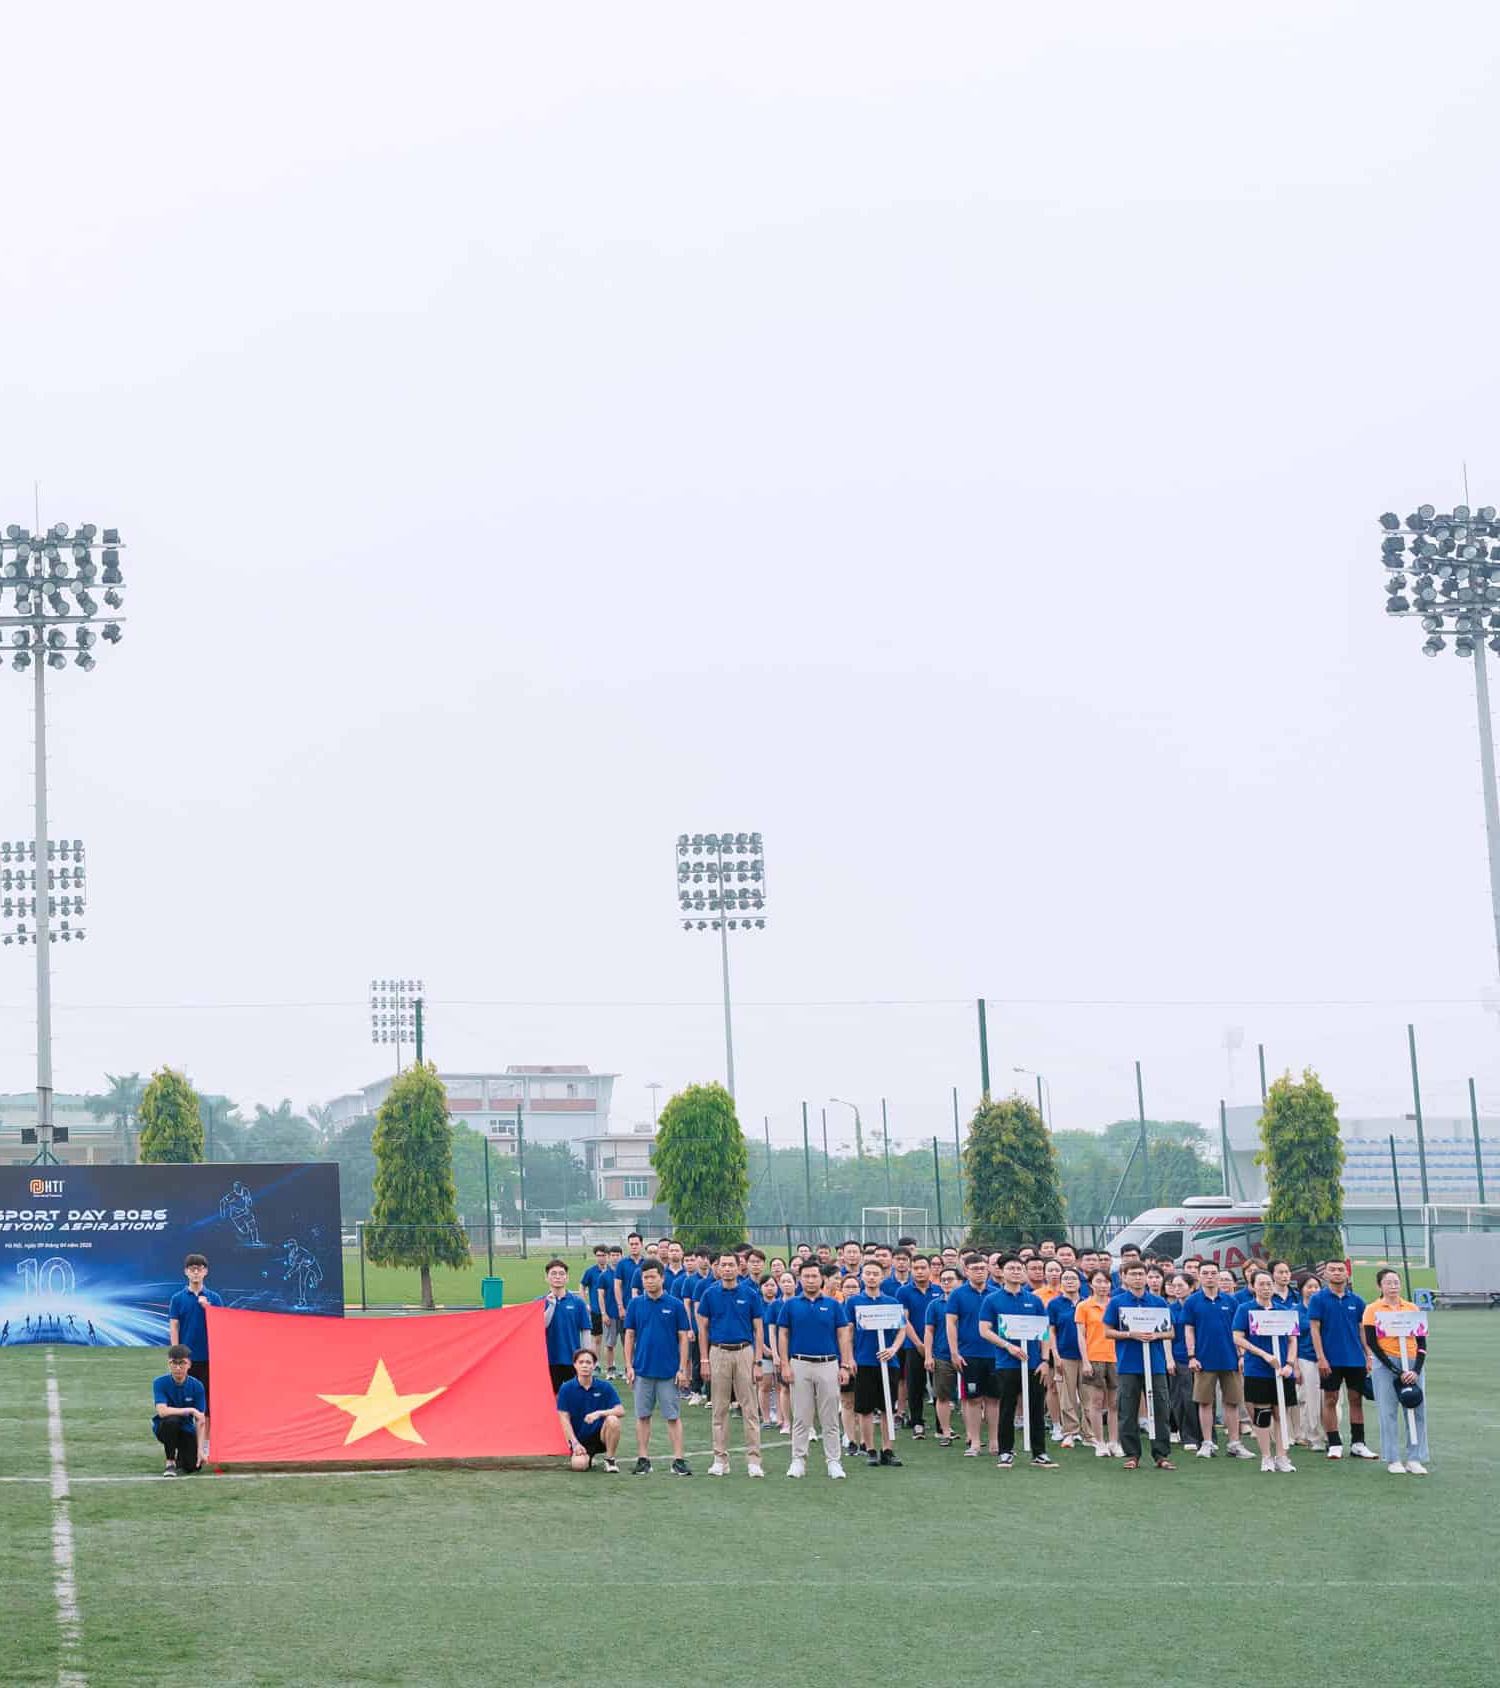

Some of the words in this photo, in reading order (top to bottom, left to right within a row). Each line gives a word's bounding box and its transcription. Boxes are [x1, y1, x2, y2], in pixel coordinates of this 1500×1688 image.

[45, 1180, 63, 1193] HTI
[67, 1209, 106, 1221] DAY
[113, 1209, 167, 1221] 2026
[59, 1222, 167, 1231] ASPIRATIONS
[16, 1257, 76, 1297] 10
